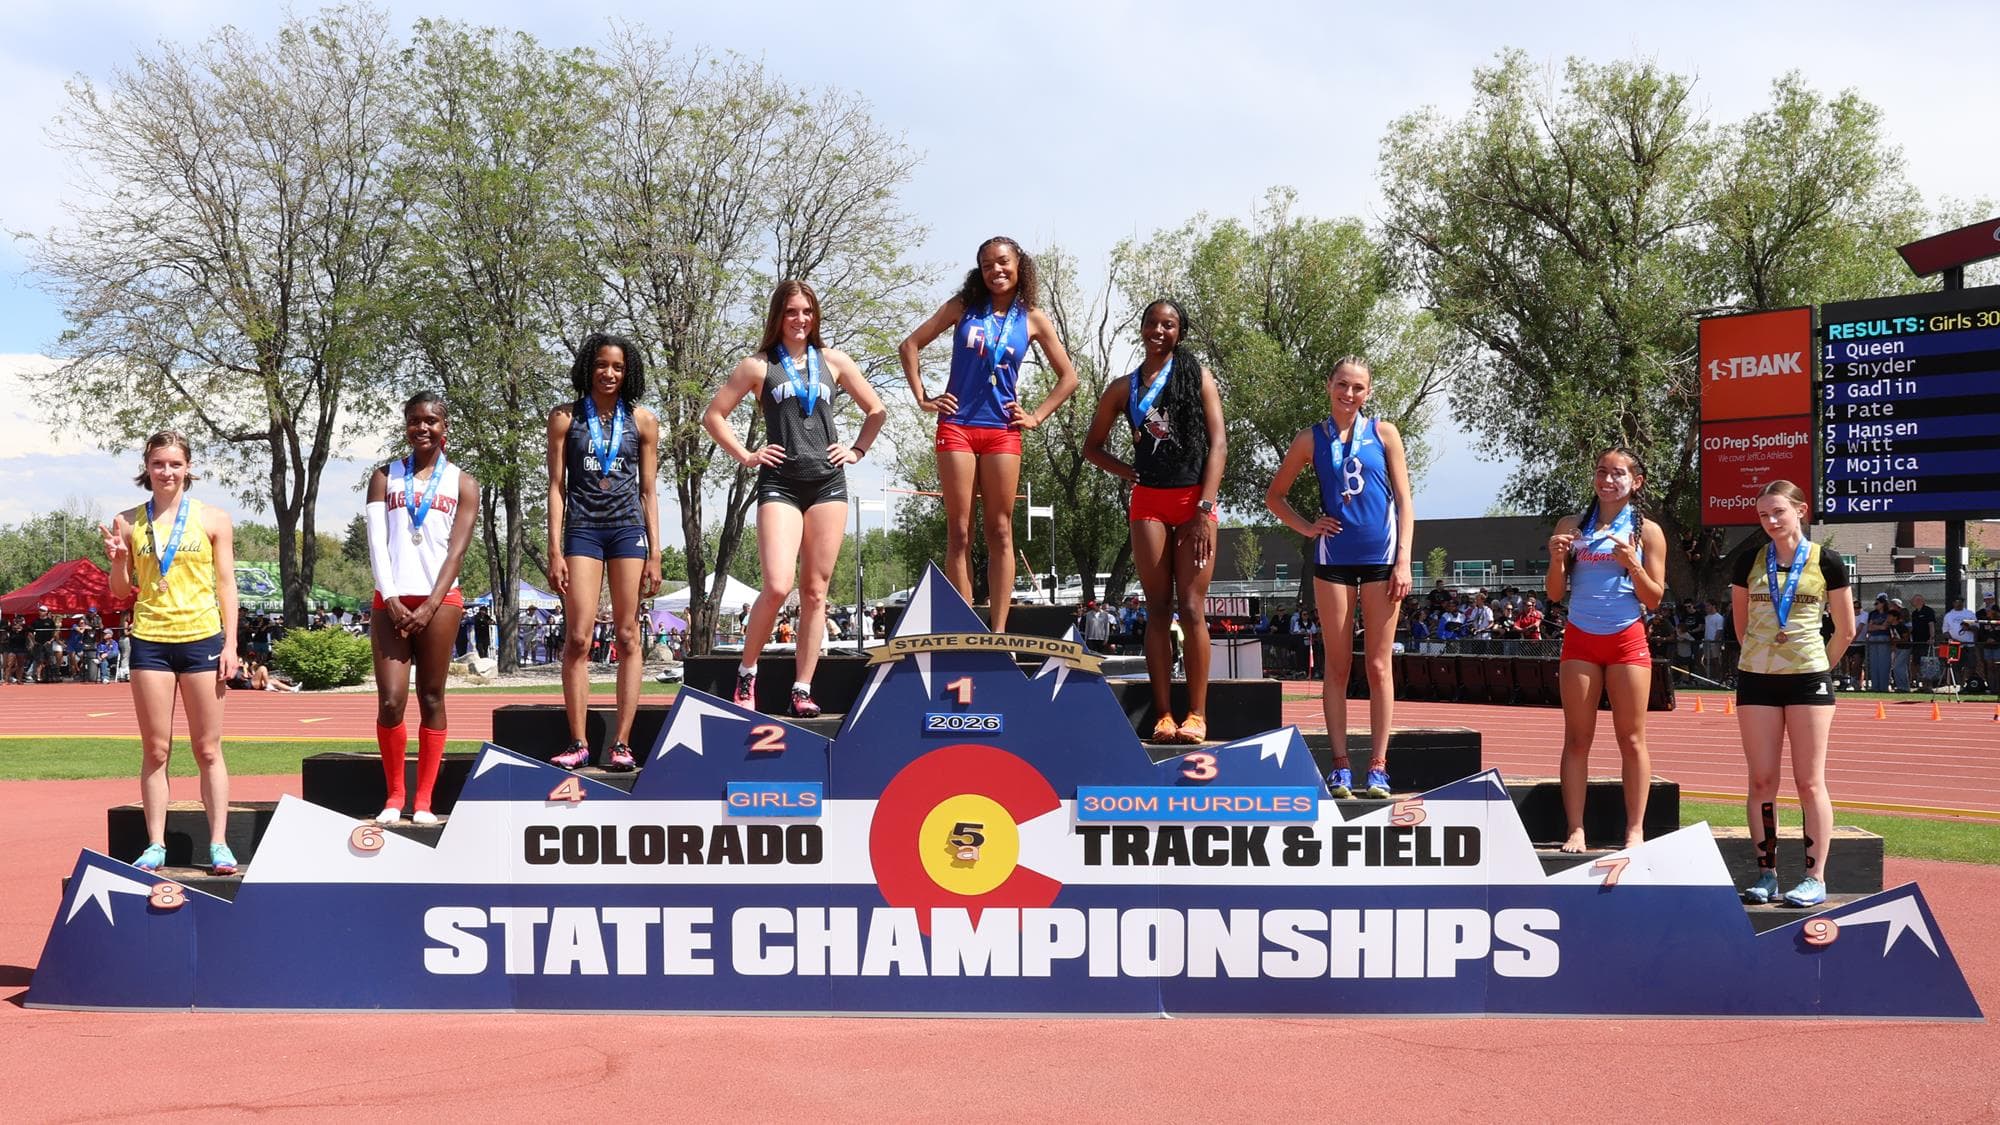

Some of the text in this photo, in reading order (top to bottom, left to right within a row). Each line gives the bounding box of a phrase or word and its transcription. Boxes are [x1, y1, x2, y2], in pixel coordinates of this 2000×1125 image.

[1829, 317, 1925, 340] RESULTS:
[1930, 314, 1972, 331] Girls
[1825, 340, 1904, 360] 1 Queen
[1824, 357, 1916, 379] 2 Snyder
[771, 380, 831, 405] VAR
[1825, 378, 1917, 400] 3 Gadlin
[1825, 402, 1894, 419] 4 Pate
[1704, 432, 1808, 451] CO Prep Spotlight
[1826, 422, 1918, 440] 5 Hansen
[1718, 454, 1728, 463] We
[1729, 454, 1746, 462] cover
[1767, 451, 1793, 460] Athletics
[1825, 437, 1893, 455] 6 Witt
[1825, 454, 1919, 474] 7 Mojica
[1825, 476, 1917, 494] 8 Linden
[1710, 495, 1756, 509] PrepSpo
[1825, 496, 1893, 512] 9 Kerr
[895, 636, 1075, 655] STATE CHAMPION
[945, 676, 974, 704] 1
[928, 715, 1001, 730] 2026
[750, 723, 786, 752] 2
[1183, 752, 1219, 780] 3
[549, 775, 588, 803] 4
[728, 792, 818, 808] GIRLS
[1083, 796, 1312, 813] 300M HURDLES
[1390, 798, 1427, 827] 5
[350, 824, 387, 852] 6
[524, 825, 824, 865] COLORADO
[950, 822, 985, 847] 5
[1075, 825, 1482, 867] TRACK & FIELD
[1594, 857, 1631, 887] 7
[149, 881, 187, 910] 8
[1802, 917, 1840, 946] 9
[423, 907, 1561, 979] STATE CHAMPIONSHIPS
